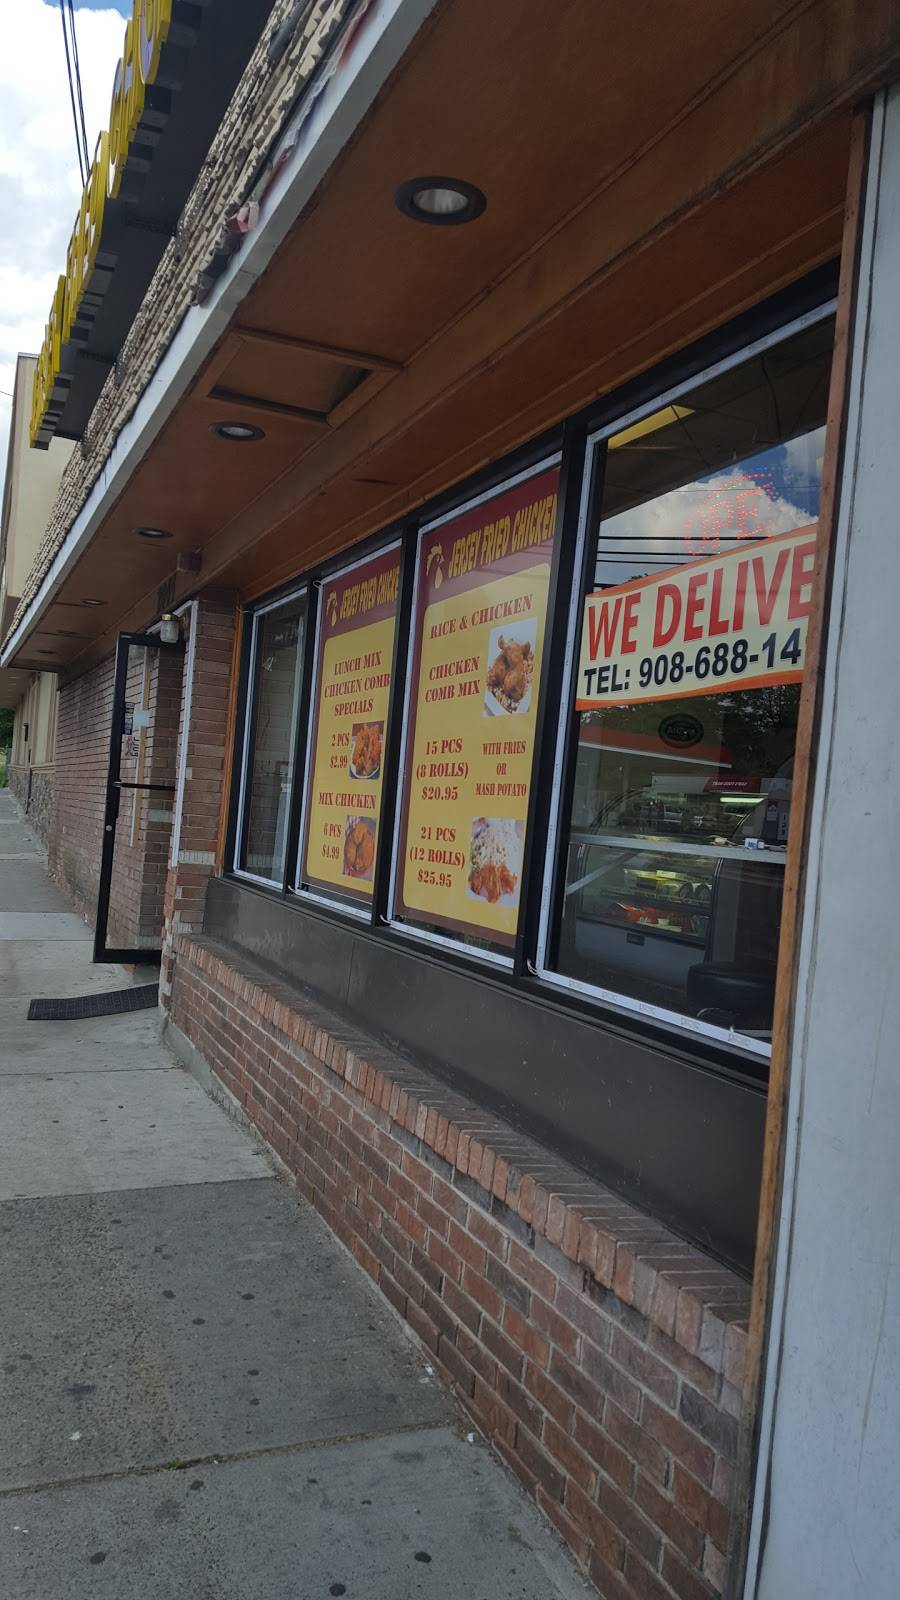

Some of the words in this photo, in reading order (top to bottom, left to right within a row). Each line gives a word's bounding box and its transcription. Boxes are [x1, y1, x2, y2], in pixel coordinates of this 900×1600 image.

[448, 528, 482, 578] JERSEY
[481, 515, 511, 566] FRIED
[588, 591, 642, 661] WE
[653, 541, 816, 648] DELIVE
[430, 618, 457, 640] RICE
[459, 615, 469, 631] &
[471, 594, 534, 627] CHICKEN
[334, 657, 361, 676] LUNCH
[363, 651, 382, 671] MIX
[429, 656, 480, 681] CHICKEN
[583, 663, 631, 696] TEL:
[638, 628, 802, 688] 908-688-14
[324, 679, 363, 699] CHICKEN
[424, 683, 456, 703] COMB
[457, 680, 480, 698] MIX
[334, 698, 374, 717] SPECIALS
[331, 736, 336, 747] 2
[337, 733, 350, 746] PCS
[426, 741, 438, 755] 15
[441, 738, 463, 754] PCS
[482, 742, 502, 756] WITH
[503, 741, 526, 755] FRIES
[329, 755, 348, 769] $2.99
[416, 765, 427, 779] (8
[429, 762, 469, 779] ROLLS)
[496, 763, 507, 776] OR
[422, 786, 459, 801] $20.95
[475, 783, 496, 796] MASH
[496, 783, 527, 797] POTATO
[318, 792, 334, 806] MIX
[335, 793, 377, 809] CHICKEN
[329, 824, 342, 838] PCS
[420, 826, 432, 840] 21
[436, 827, 456, 842] PCS
[409, 847, 424, 863] (12
[428, 849, 466, 870] ROLLS)
[417, 869, 453, 888] $25.95
